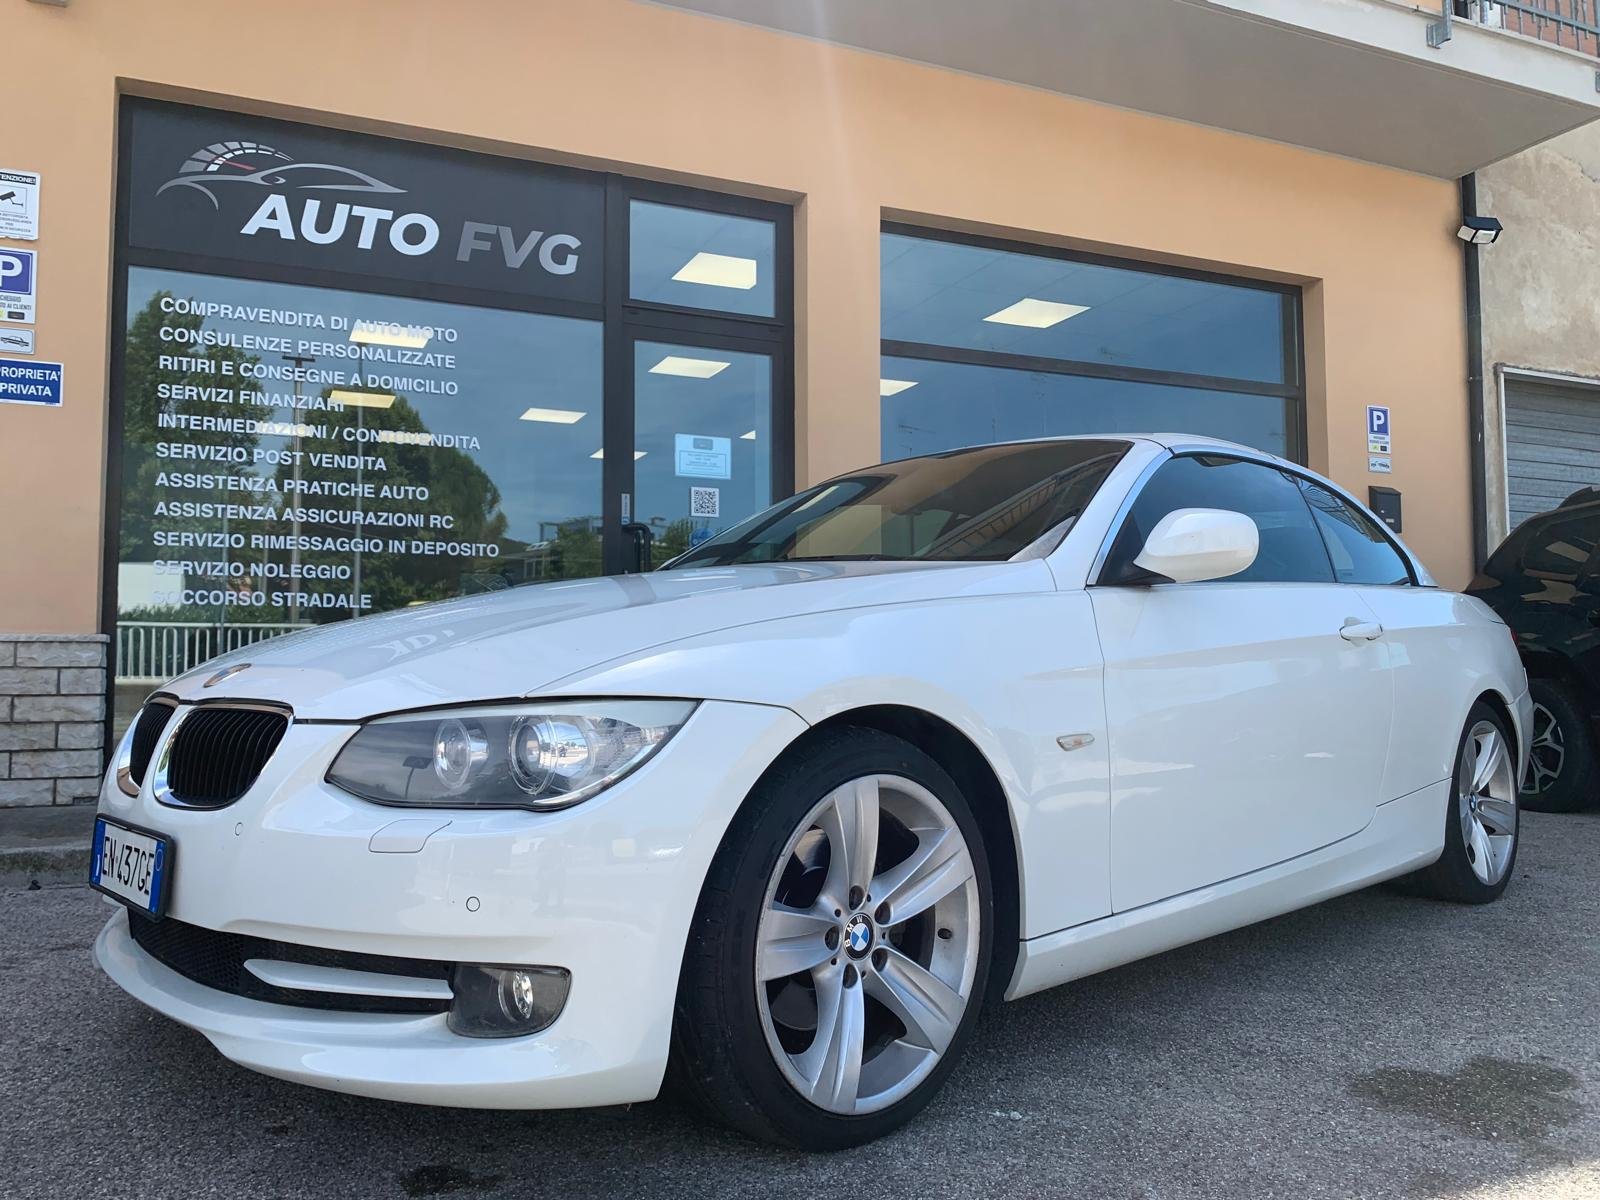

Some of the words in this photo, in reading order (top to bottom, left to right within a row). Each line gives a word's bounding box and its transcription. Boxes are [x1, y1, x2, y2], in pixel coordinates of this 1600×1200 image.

[240, 193, 439, 255] AUTO
[456, 220, 582, 275] FVG
[0, 254, 22, 288] P
[160, 297, 326, 329] COMPRAVENDITA
[330, 316, 348, 331] DI
[353, 319, 401, 337] AUTO
[407, 324, 458, 342] MOTO
[159, 327, 292, 353] CONSULENZE
[298, 339, 456, 369] PERSONALIZZATE
[0, 366, 60, 381] ROPRIETA'
[159, 355, 215, 374] RITIRI
[222, 360, 233, 376] E
[239, 362, 345, 386] CONSEGNE
[350, 371, 362, 387] A
[367, 373, 458, 396] DOMICILIO
[0, 382, 52, 397] PRIVATA
[157, 383, 233, 403] SERVIZI
[240, 390, 344, 412] FINANZIARI
[158, 413, 327, 438] INTERMEDIAZIONI
[1372, 410, 1385, 432] P
[155, 442, 246, 463] SERVIZIO
[253, 449, 303, 466] POST
[310, 453, 387, 471] VENDITA
[155, 472, 278, 493] ASSISTENZA
[284, 479, 375, 498] PRATICHE
[380, 485, 429, 501] AUTO
[154, 501, 277, 521] ASSISTENZA
[282, 507, 424, 528] ASSICURAZIONI
[429, 514, 454, 529] RC
[153, 530, 245, 549] SERVIZIO
[251, 534, 383, 554] RIMESSAGGIO
[389, 539, 405, 555] IN
[411, 540, 499, 558] DEPOSITO
[153, 559, 244, 577] SERVIZIO
[250, 562, 351, 580] NOLEGGIO
[271, 591, 372, 609] STRADALE
